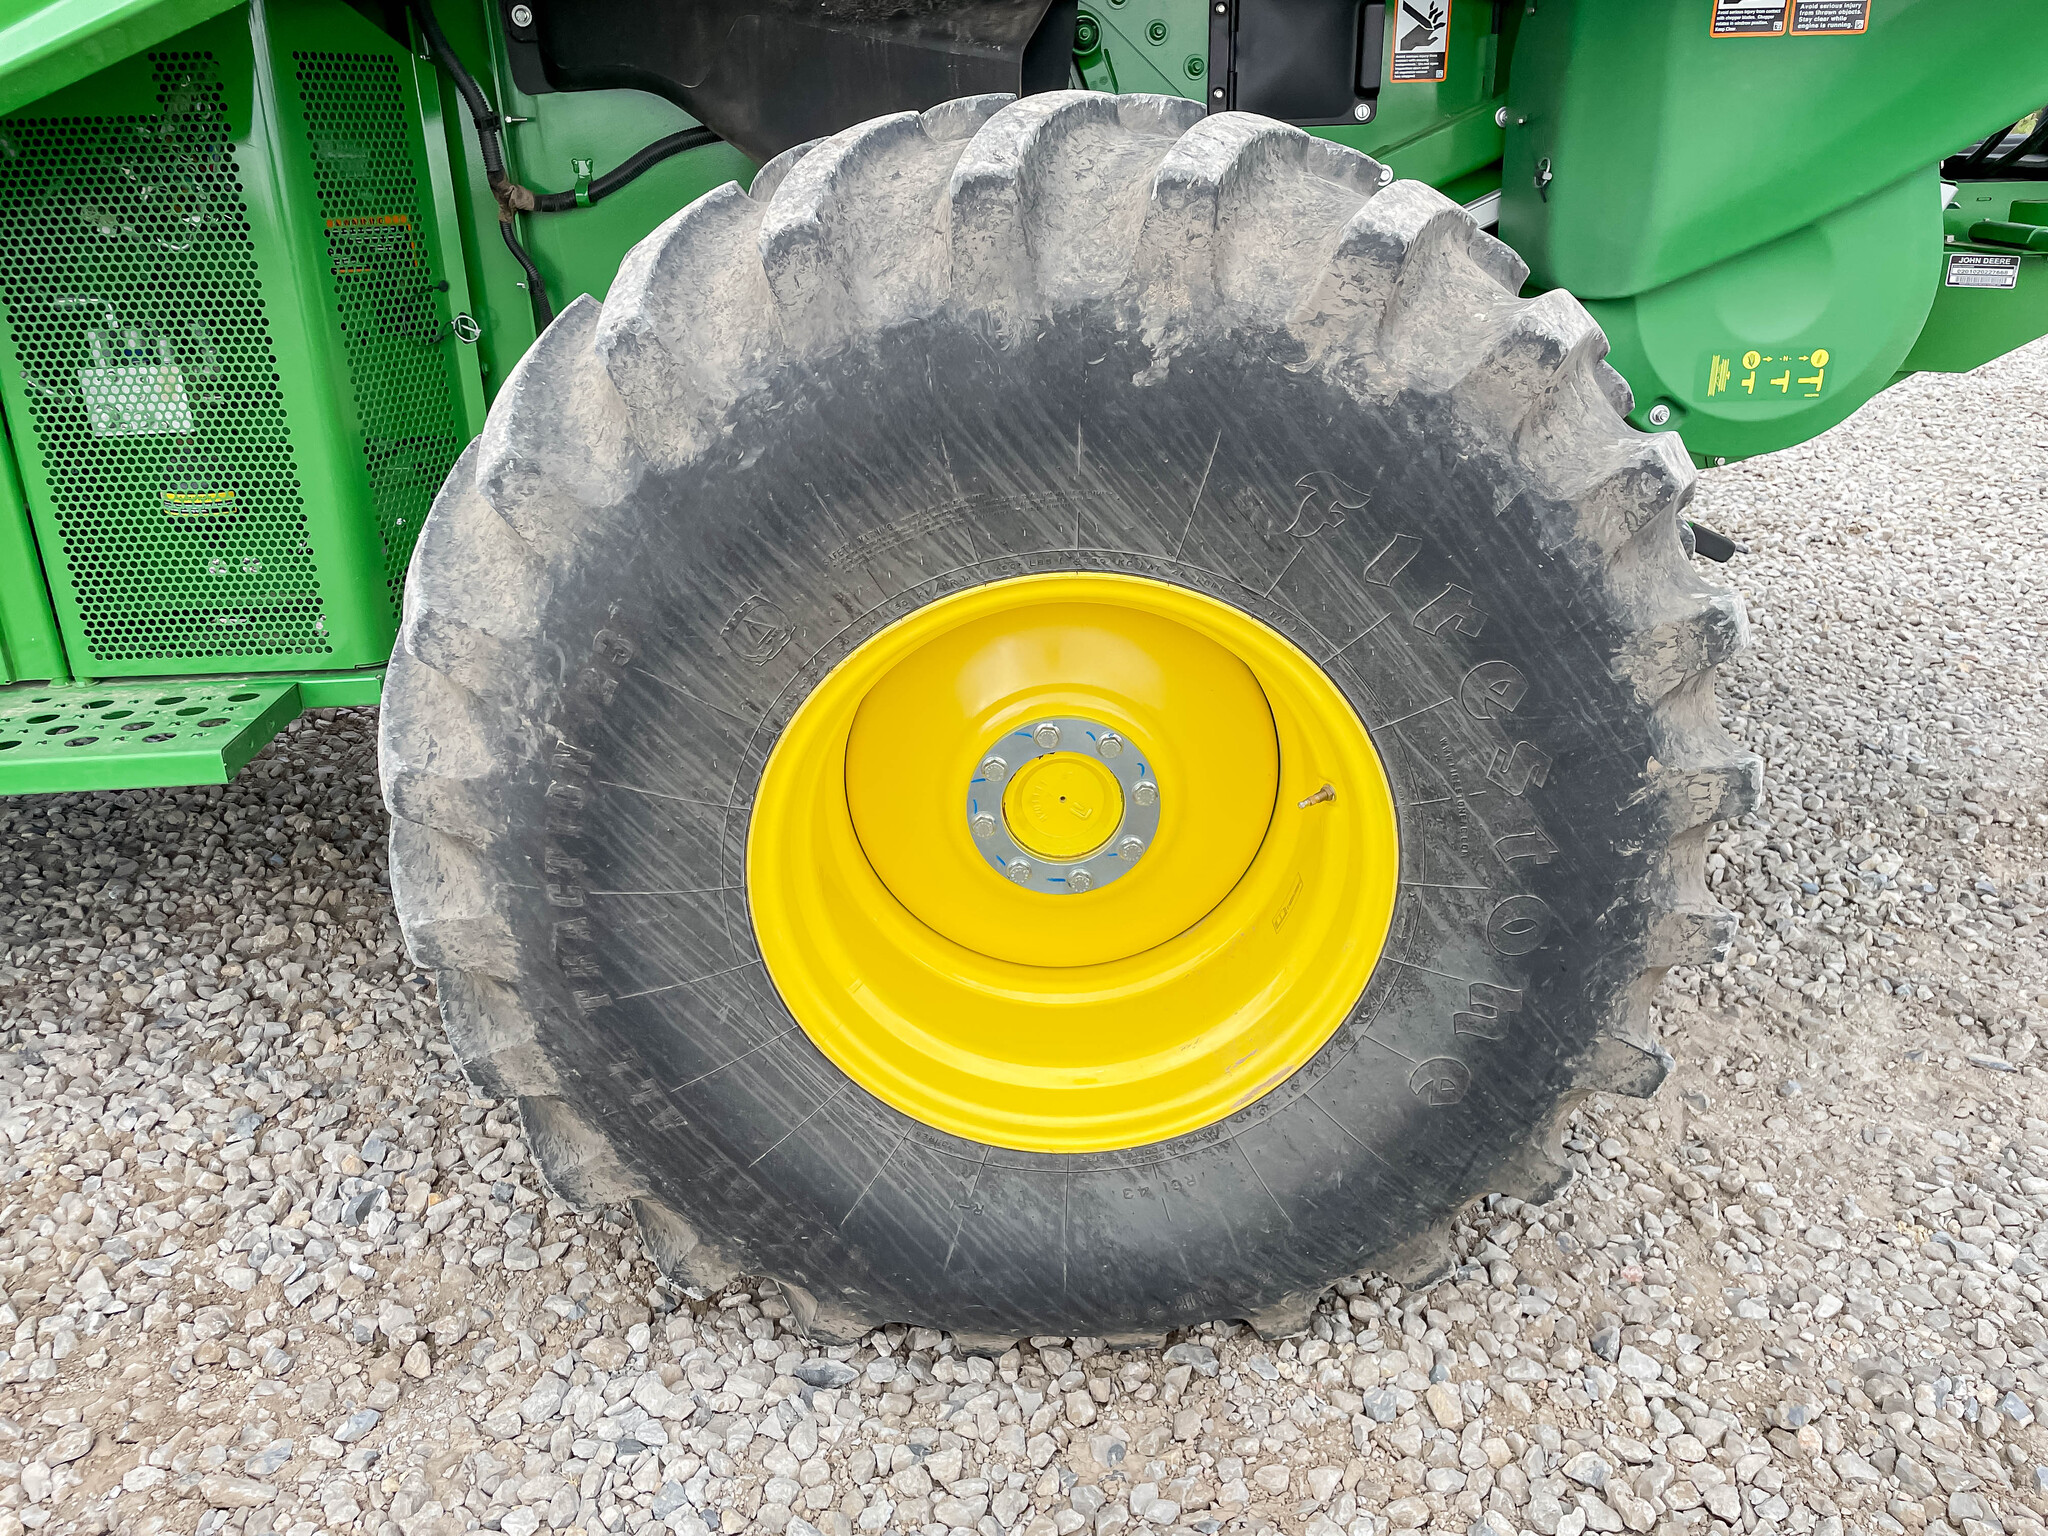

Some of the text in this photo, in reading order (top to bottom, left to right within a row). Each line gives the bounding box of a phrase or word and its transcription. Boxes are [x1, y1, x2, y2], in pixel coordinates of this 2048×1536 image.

[1843, 2, 1862, 10] injury
[1838, 8, 1863, 16] objects.
[1797, 22, 1819, 30] engine
[1982, 257, 2012, 265] DEERE
[1284, 470, 1560, 1107] Firestone
[543, 738, 613, 1017] TRACTION
